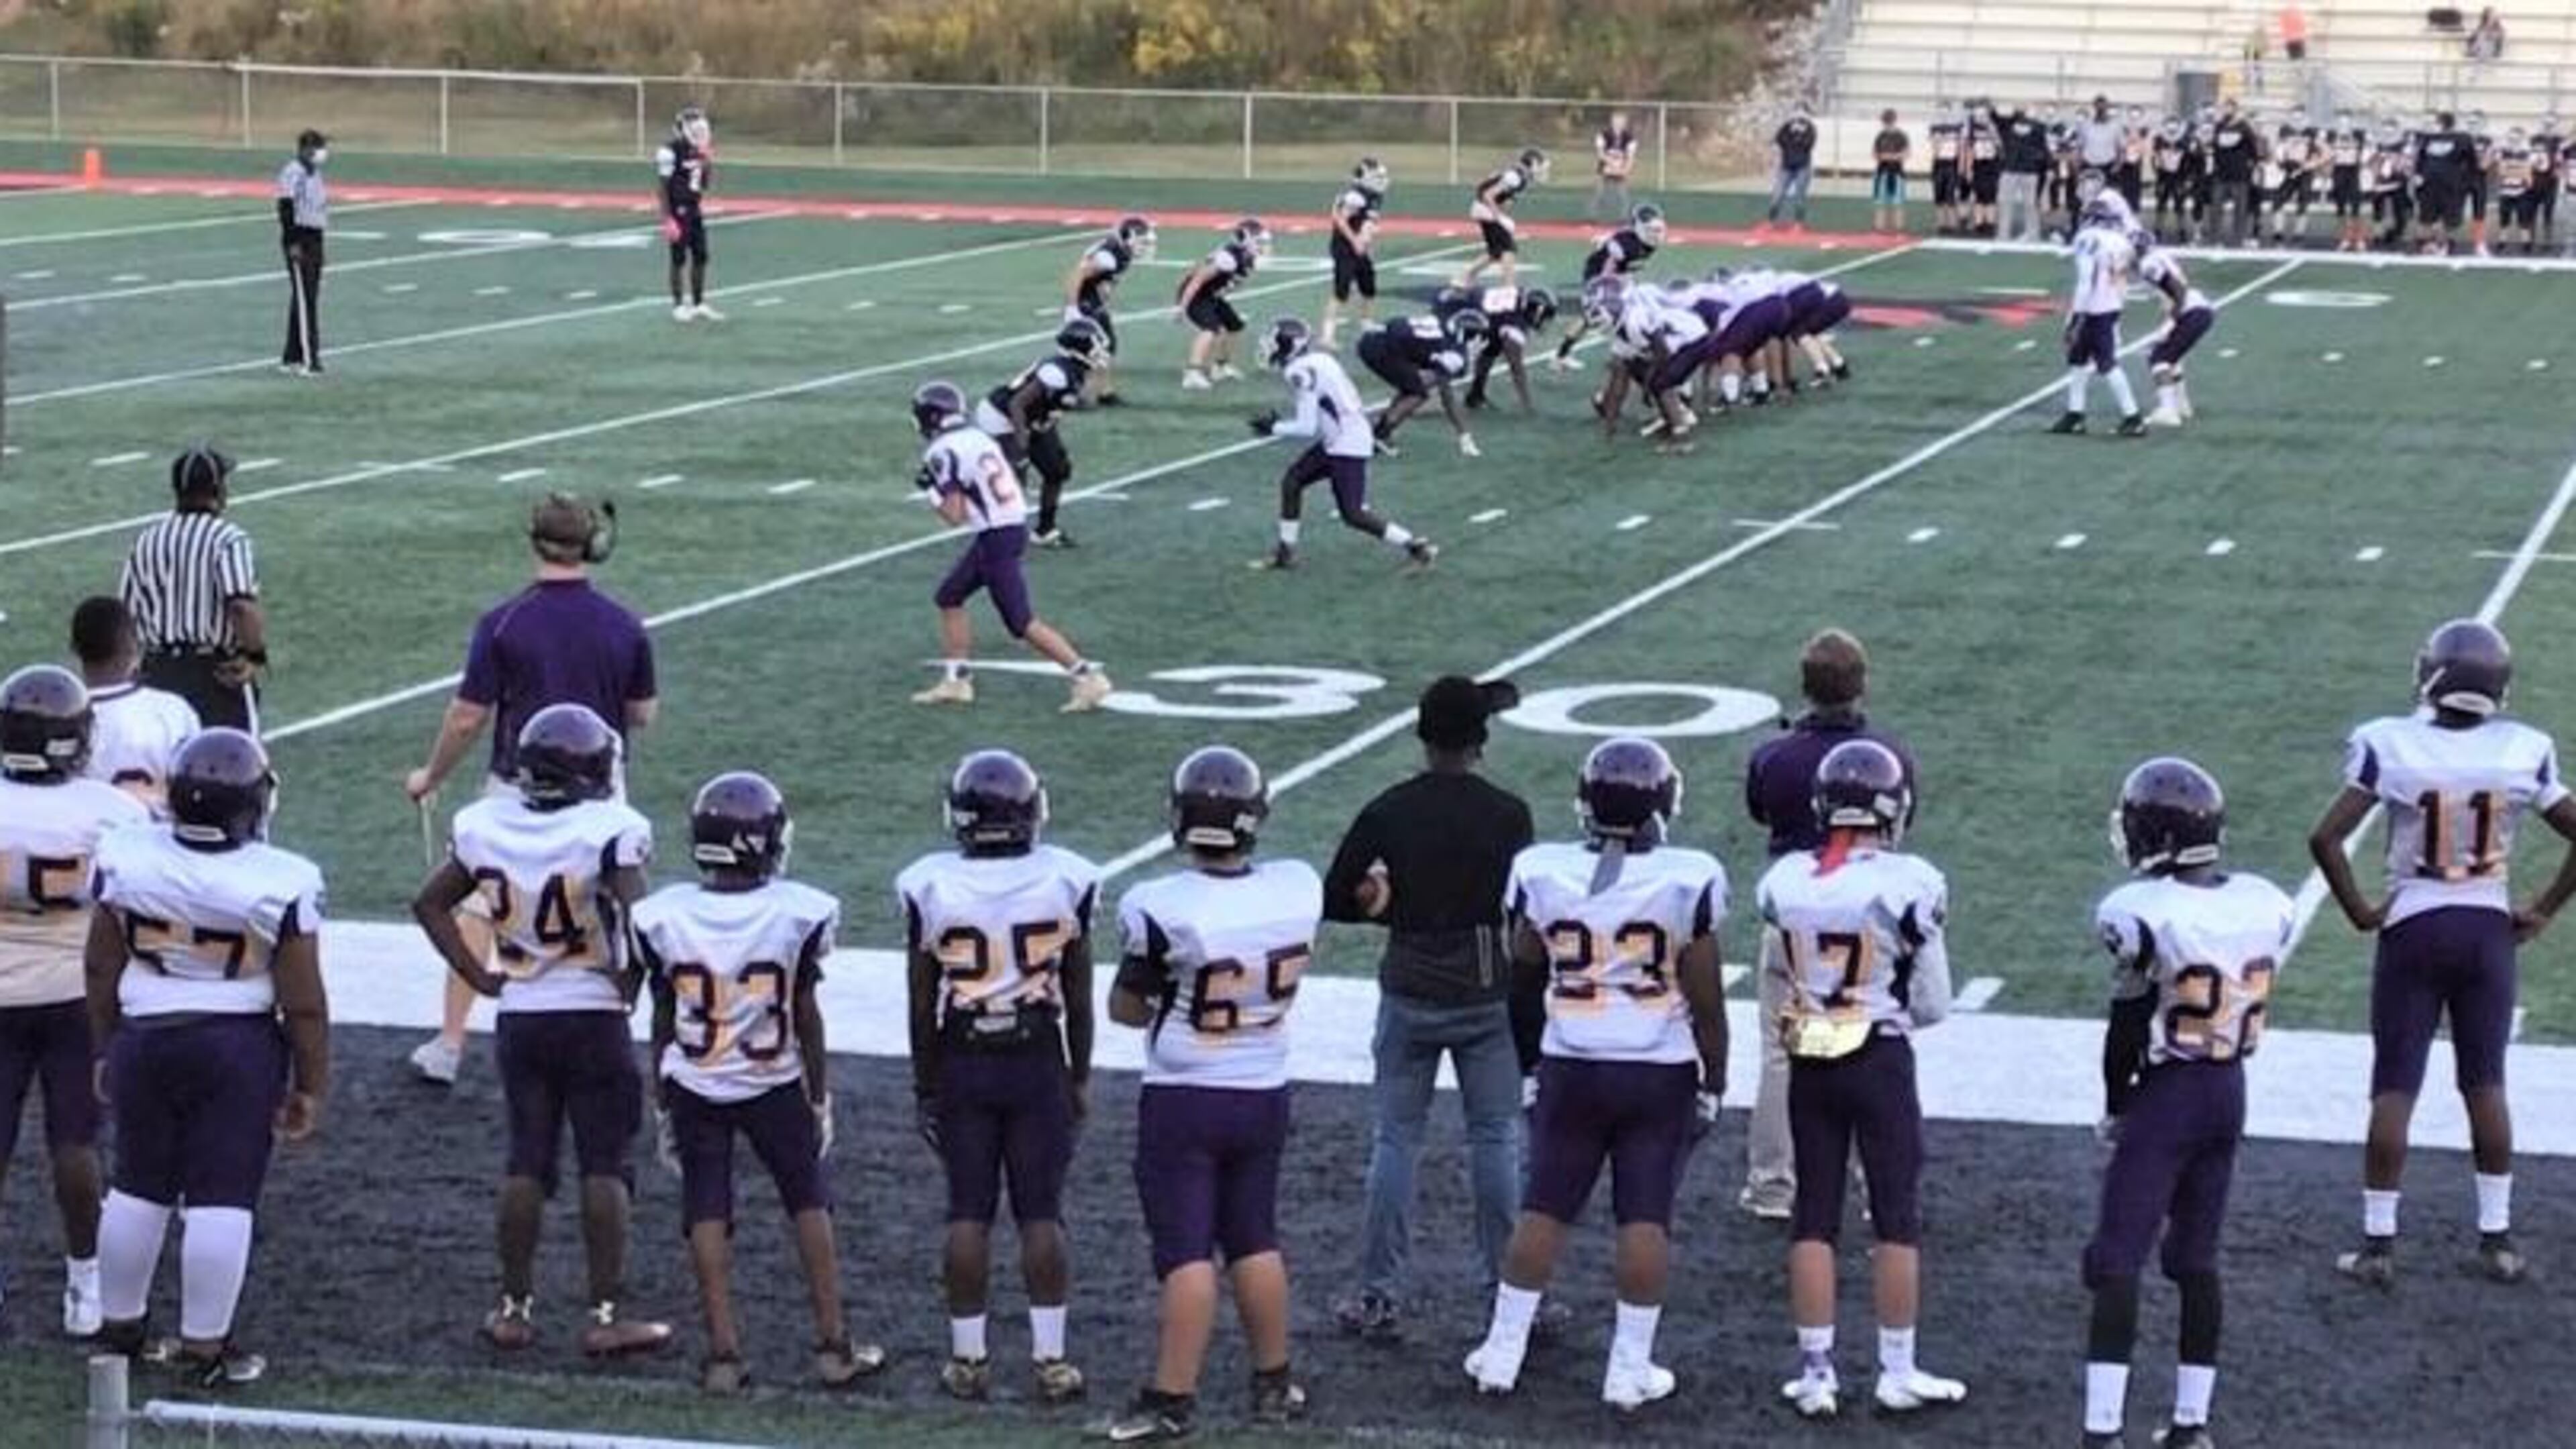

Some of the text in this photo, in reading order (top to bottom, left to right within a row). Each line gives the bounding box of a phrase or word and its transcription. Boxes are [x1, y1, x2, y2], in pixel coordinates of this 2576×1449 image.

[2416, 790, 2500, 879] 11
[129, 910, 246, 980] 57
[939, 920, 1060, 1006] 25
[1190, 942, 1310, 1033] 65
[1546, 920, 1669, 1000] 23
[672, 963, 788, 1060] 33
[2165, 956, 2275, 1058] 22
